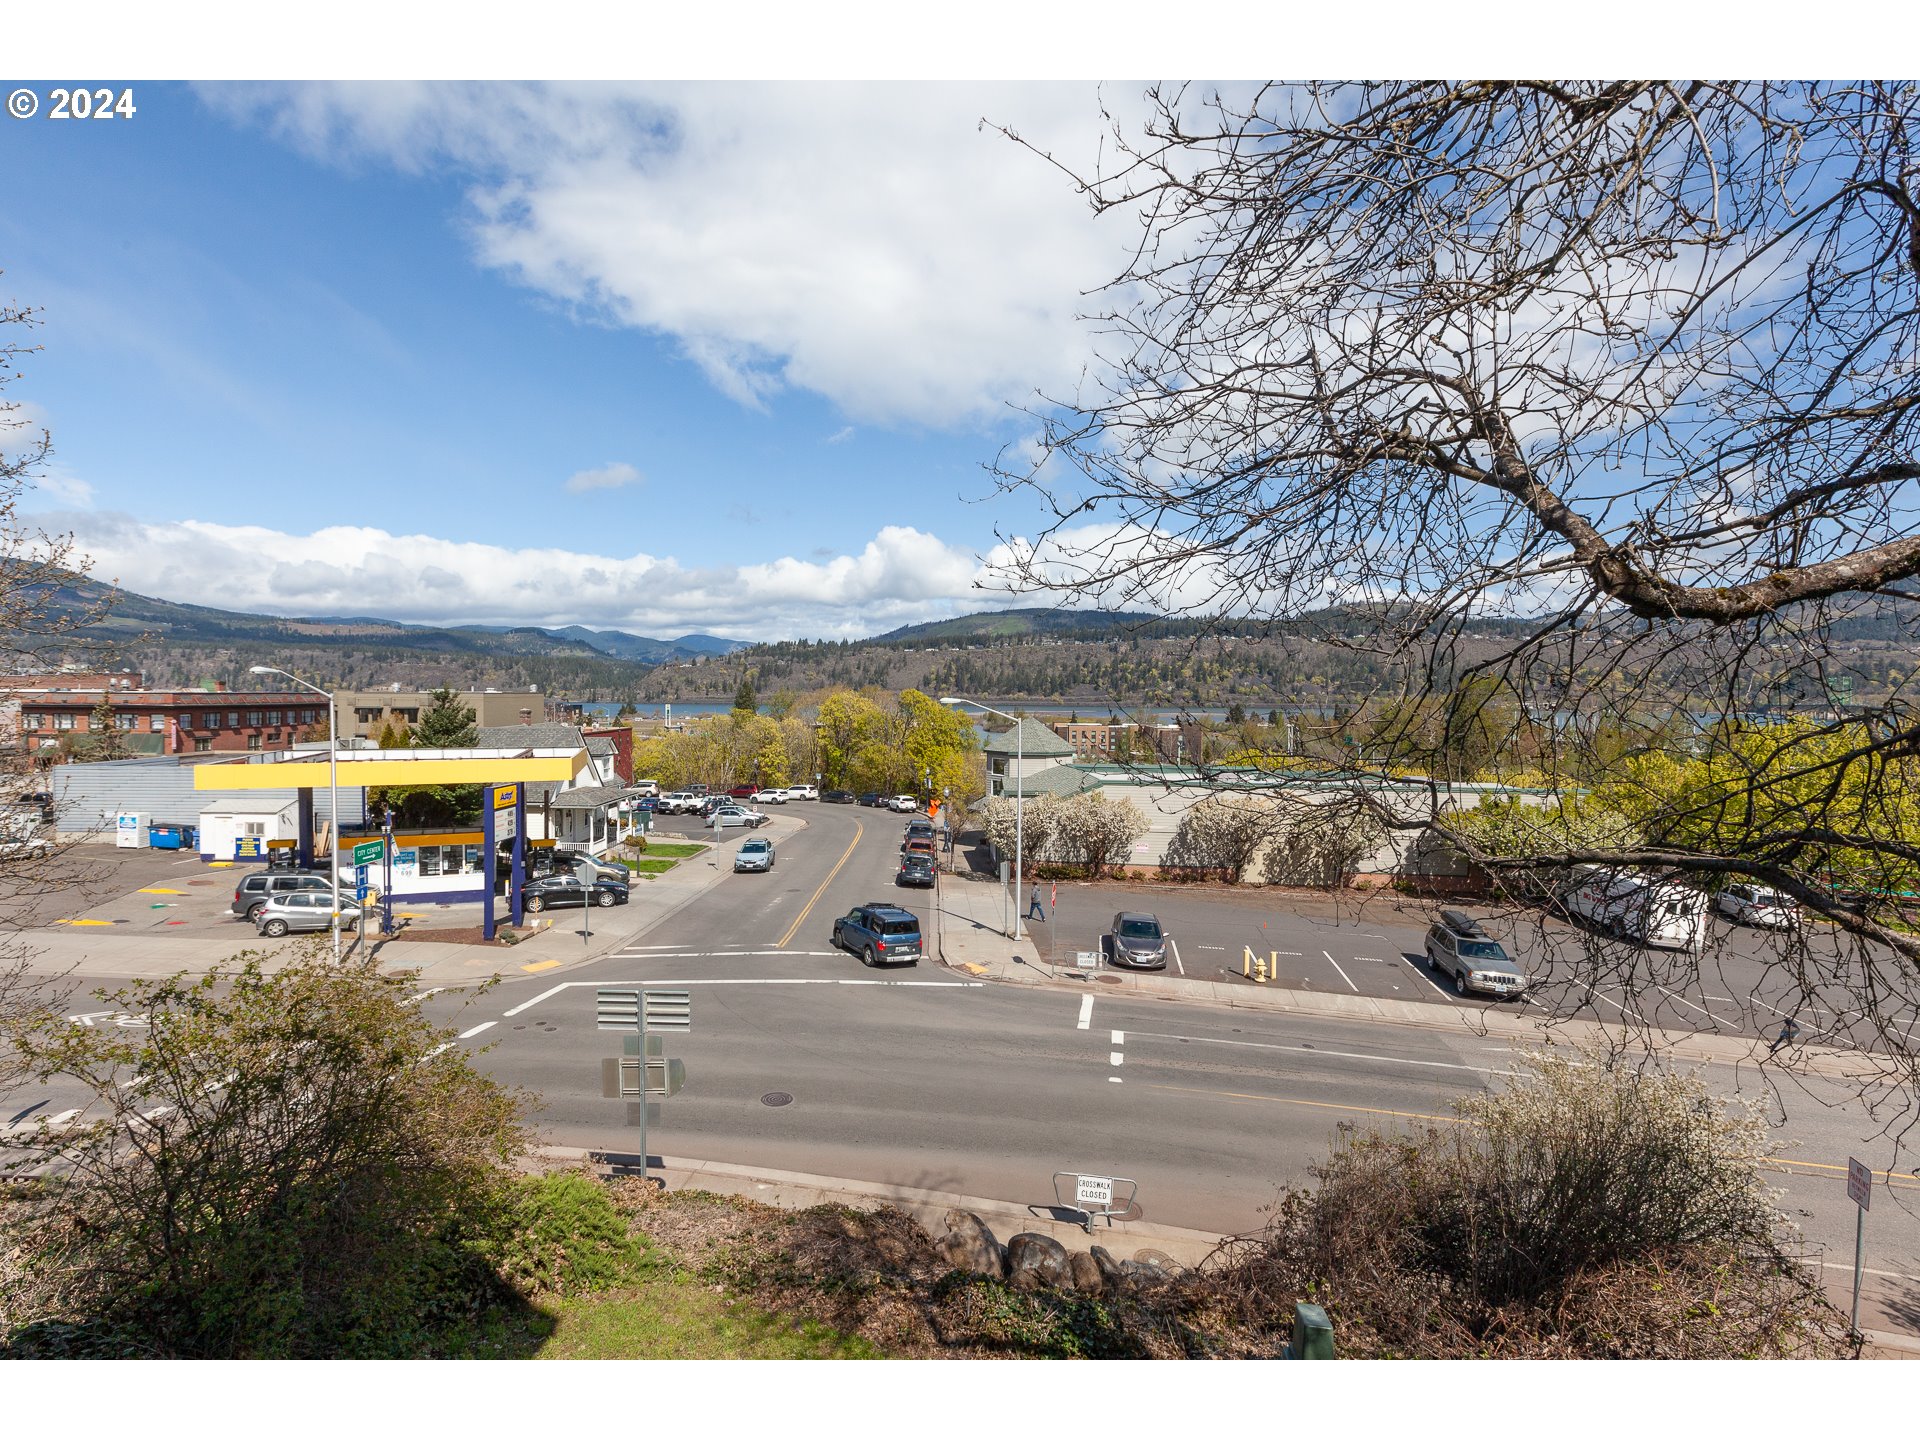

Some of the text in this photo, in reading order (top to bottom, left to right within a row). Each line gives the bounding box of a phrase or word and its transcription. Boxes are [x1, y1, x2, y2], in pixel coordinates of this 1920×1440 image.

[366, 846, 381, 854] CENTER
[358, 866, 366, 887] H
[1079, 1180, 1111, 1190] CROSSWALK
[1082, 1190, 1107, 1200] CLOSED
